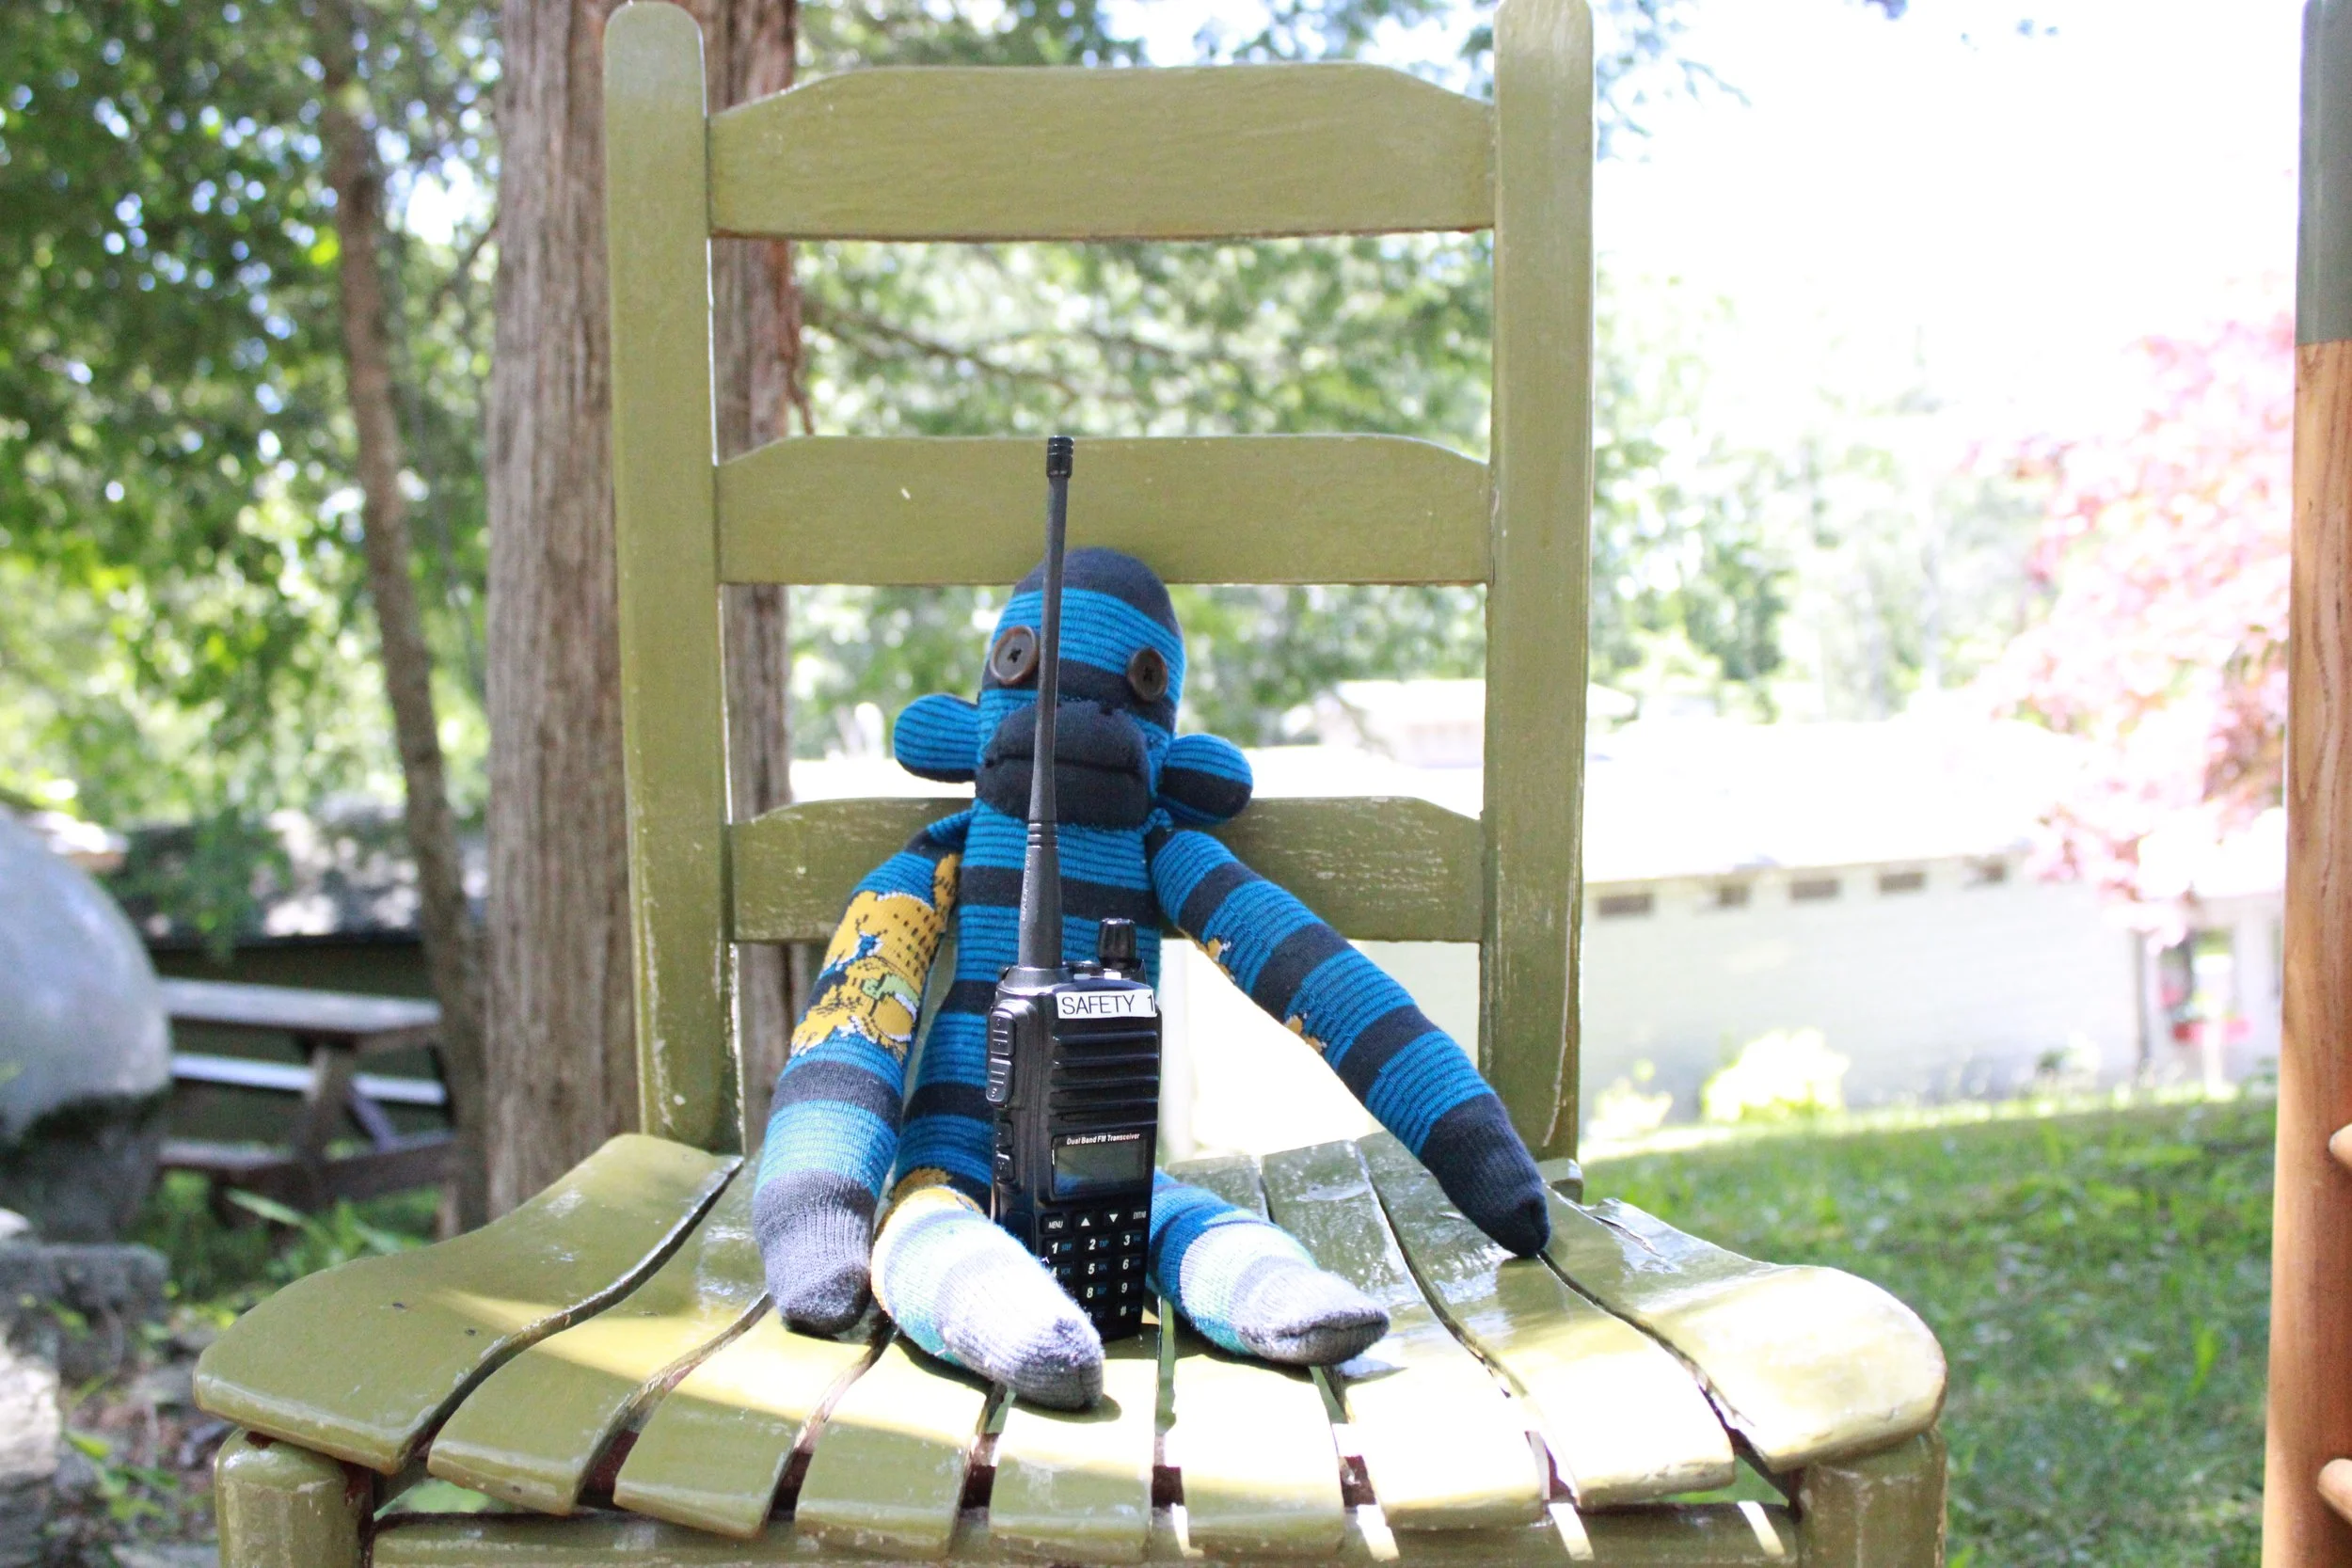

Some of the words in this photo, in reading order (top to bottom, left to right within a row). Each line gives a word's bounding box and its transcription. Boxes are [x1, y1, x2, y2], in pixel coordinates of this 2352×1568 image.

[1061, 994, 1135, 1015] SAFETY
[1147, 994, 1154, 1012] 1
[1066, 1137, 1081, 1146] Dual
[1081, 1135, 1097, 1145] Band
[1097, 1134, 1106, 1143] FM
[1107, 1132, 1140, 1142] Transceiver
[1089, 1239, 1096, 1250] 2
[1123, 1235, 1130, 1245] 3
[1052, 1243, 1058, 1254] 1
[1088, 1263, 1095, 1275] 5
[1122, 1259, 1129, 1270] 6
[1087, 1287, 1093, 1298] 8
[1121, 1282, 1127, 1293] 9
